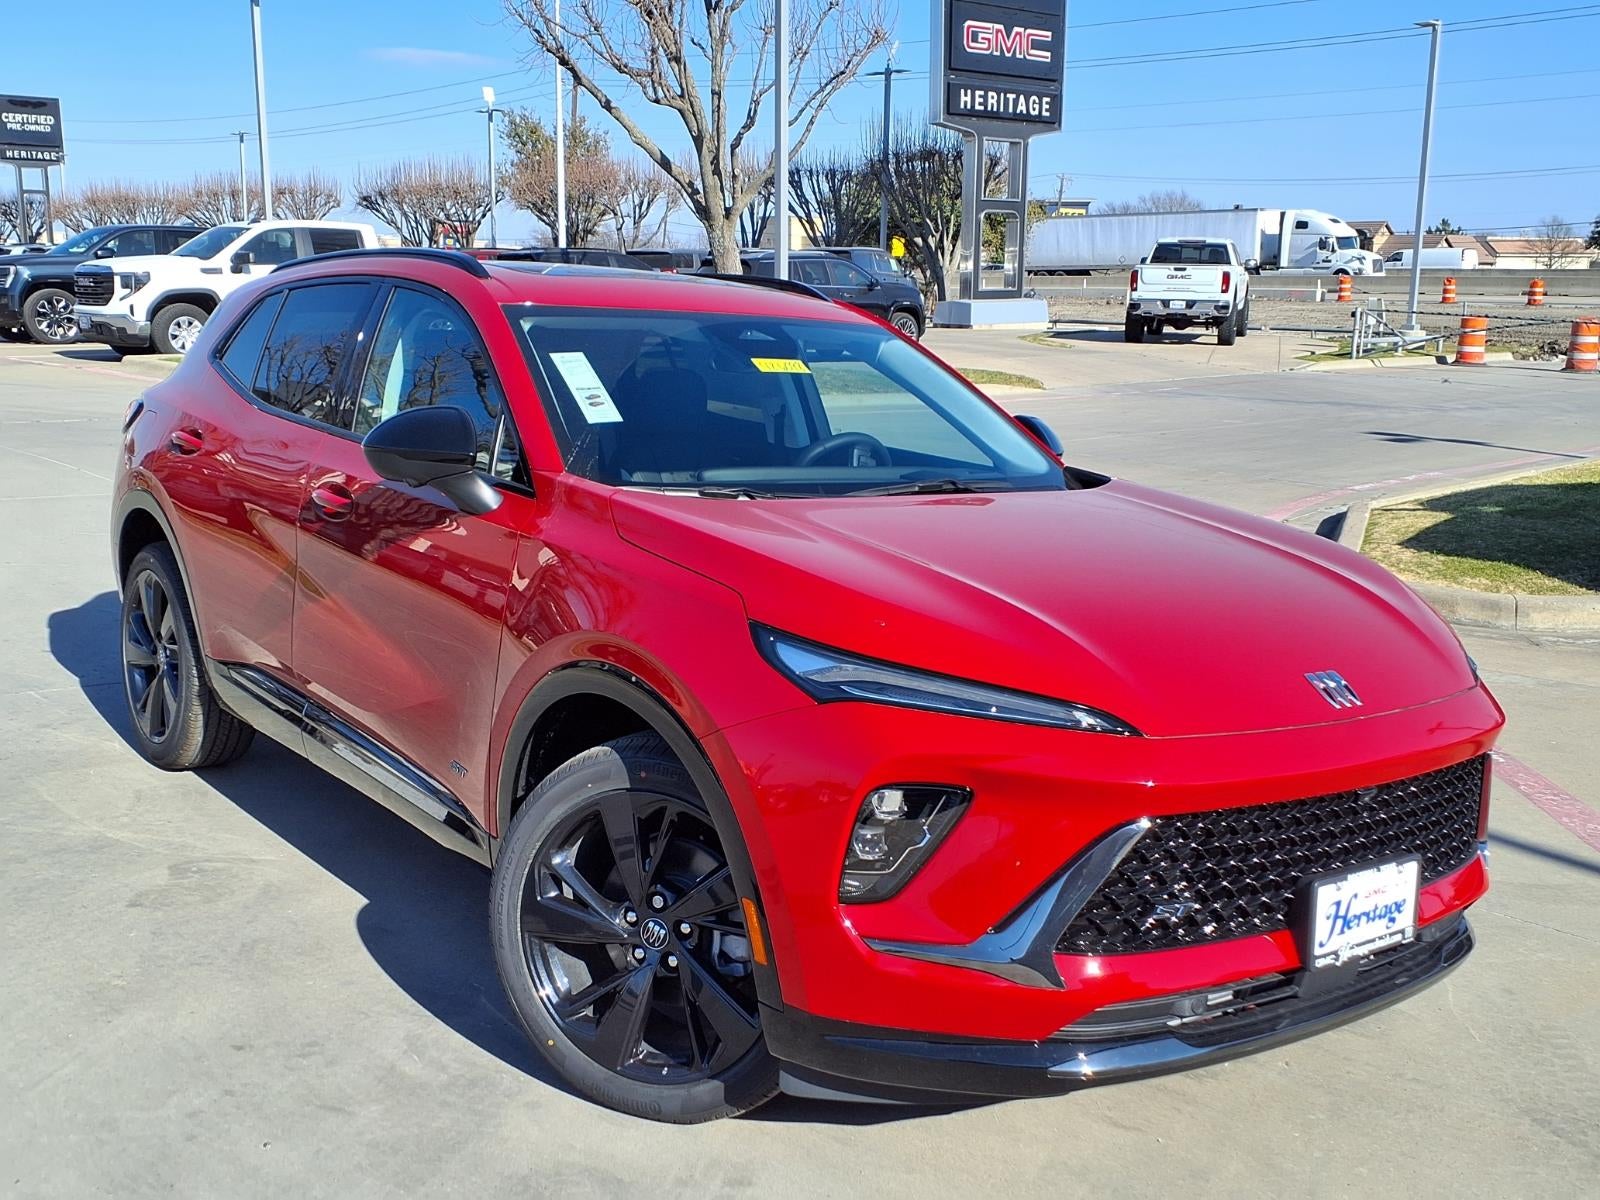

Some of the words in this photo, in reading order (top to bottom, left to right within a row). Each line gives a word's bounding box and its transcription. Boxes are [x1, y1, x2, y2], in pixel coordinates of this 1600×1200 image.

[963, 20, 1052, 62] GMC
[960, 88, 1051, 117] HERITAGE
[1, 112, 55, 125] CERTIFIED
[6, 123, 51, 132] PRE-OWNED
[6, 150, 57, 160] HERITAGE
[1318, 892, 1407, 949] Heritage
